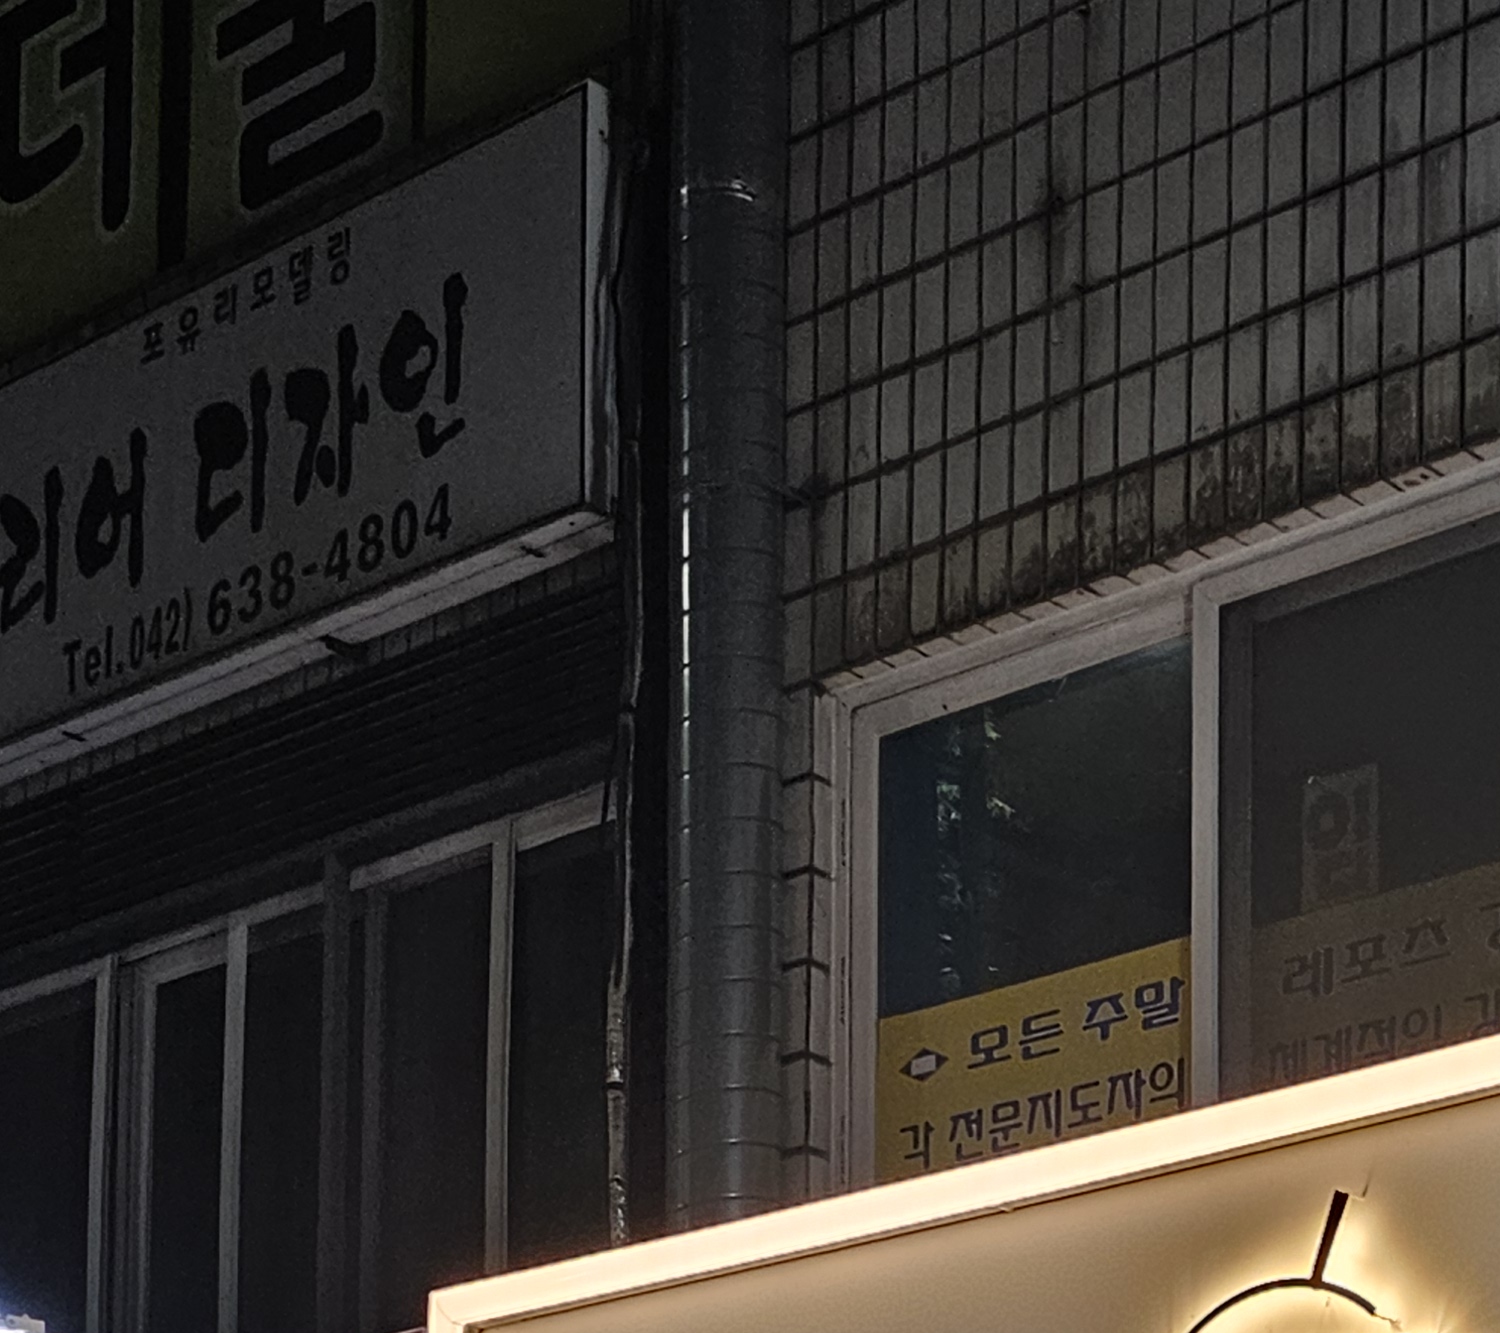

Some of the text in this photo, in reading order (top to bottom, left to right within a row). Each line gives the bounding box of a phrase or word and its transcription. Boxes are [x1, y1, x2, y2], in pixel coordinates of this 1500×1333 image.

[194, 271, 468, 542] 디자인
[966, 1008, 1065, 1071] 모든
[1082, 976, 1187, 1042] 주말
[899, 1120, 936, 1171] 각
[949, 1056, 1186, 1163] 전문지도자의
